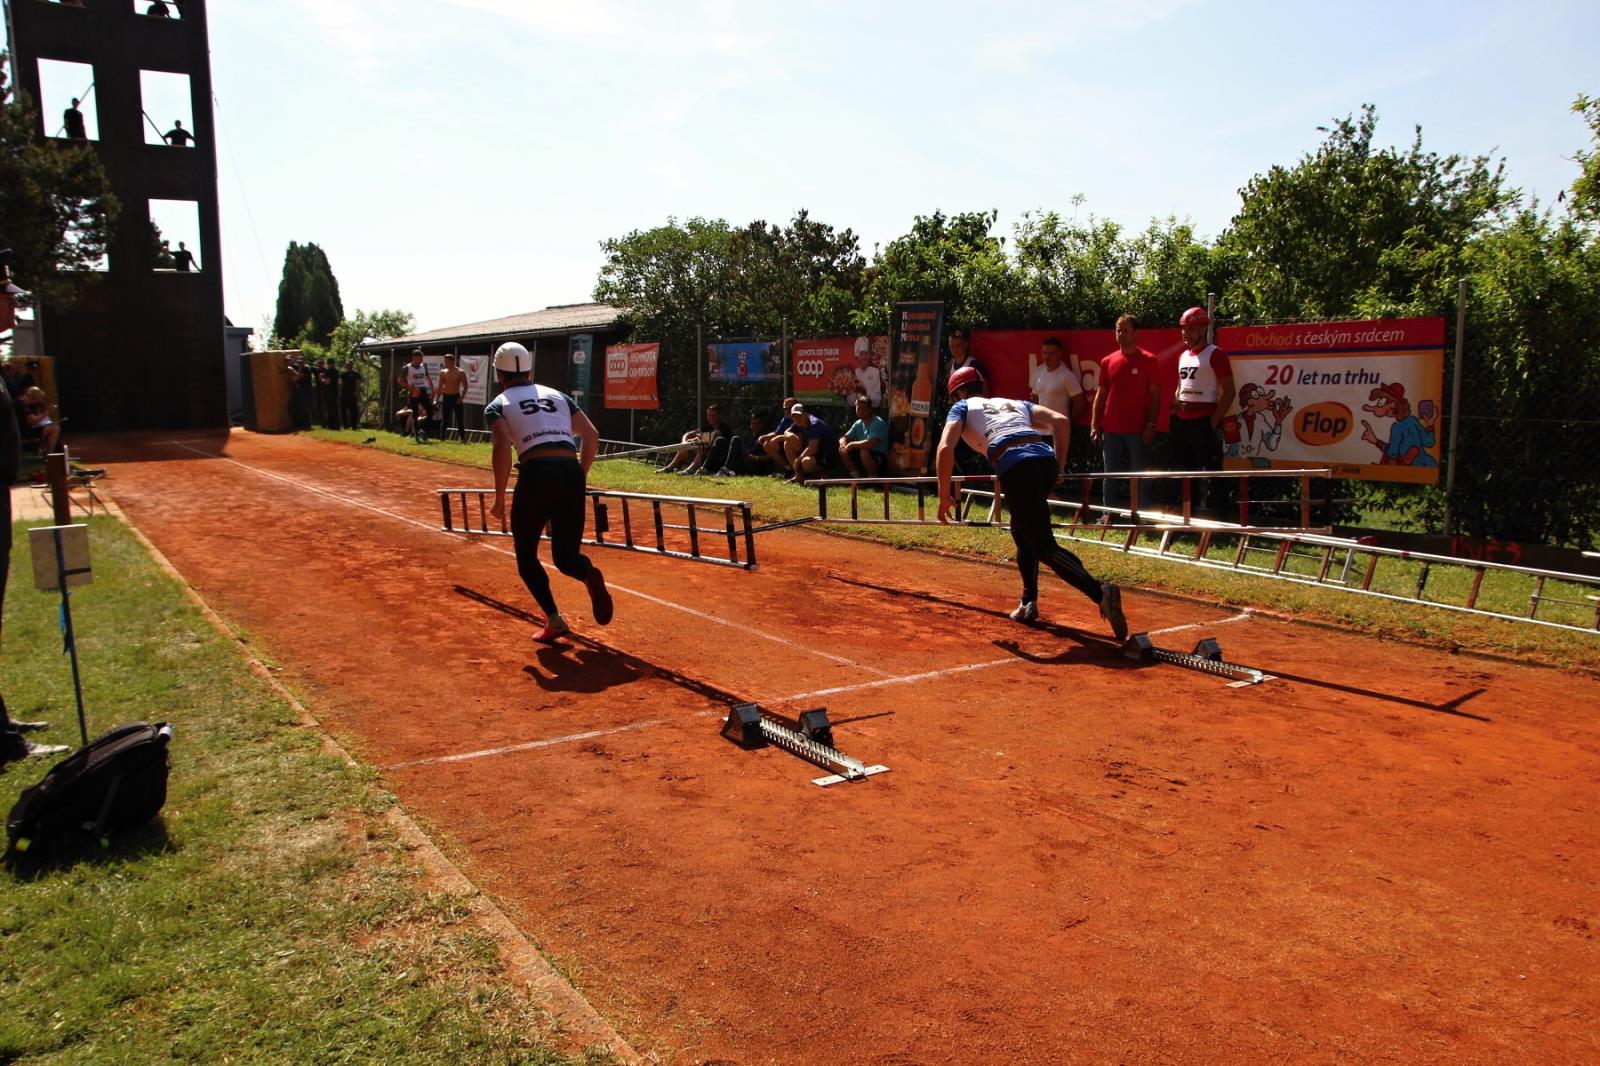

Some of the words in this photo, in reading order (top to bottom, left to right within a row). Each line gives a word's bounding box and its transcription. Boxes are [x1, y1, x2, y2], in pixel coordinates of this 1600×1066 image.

[1246, 332, 1295, 347] Obchod
[1296, 335, 1302, 345] s
[1304, 330, 1351, 348] českým
[1354, 328, 1405, 343] srdcem
[797, 360, 824, 379] coop
[1180, 366, 1199, 380] 57
[1264, 364, 1294, 386] 20
[1297, 369, 1317, 386] let
[1321, 372, 1341, 385] na
[1345, 368, 1381, 385] trhu
[518, 398, 558, 416] 53
[1301, 411, 1348, 438] Flop
